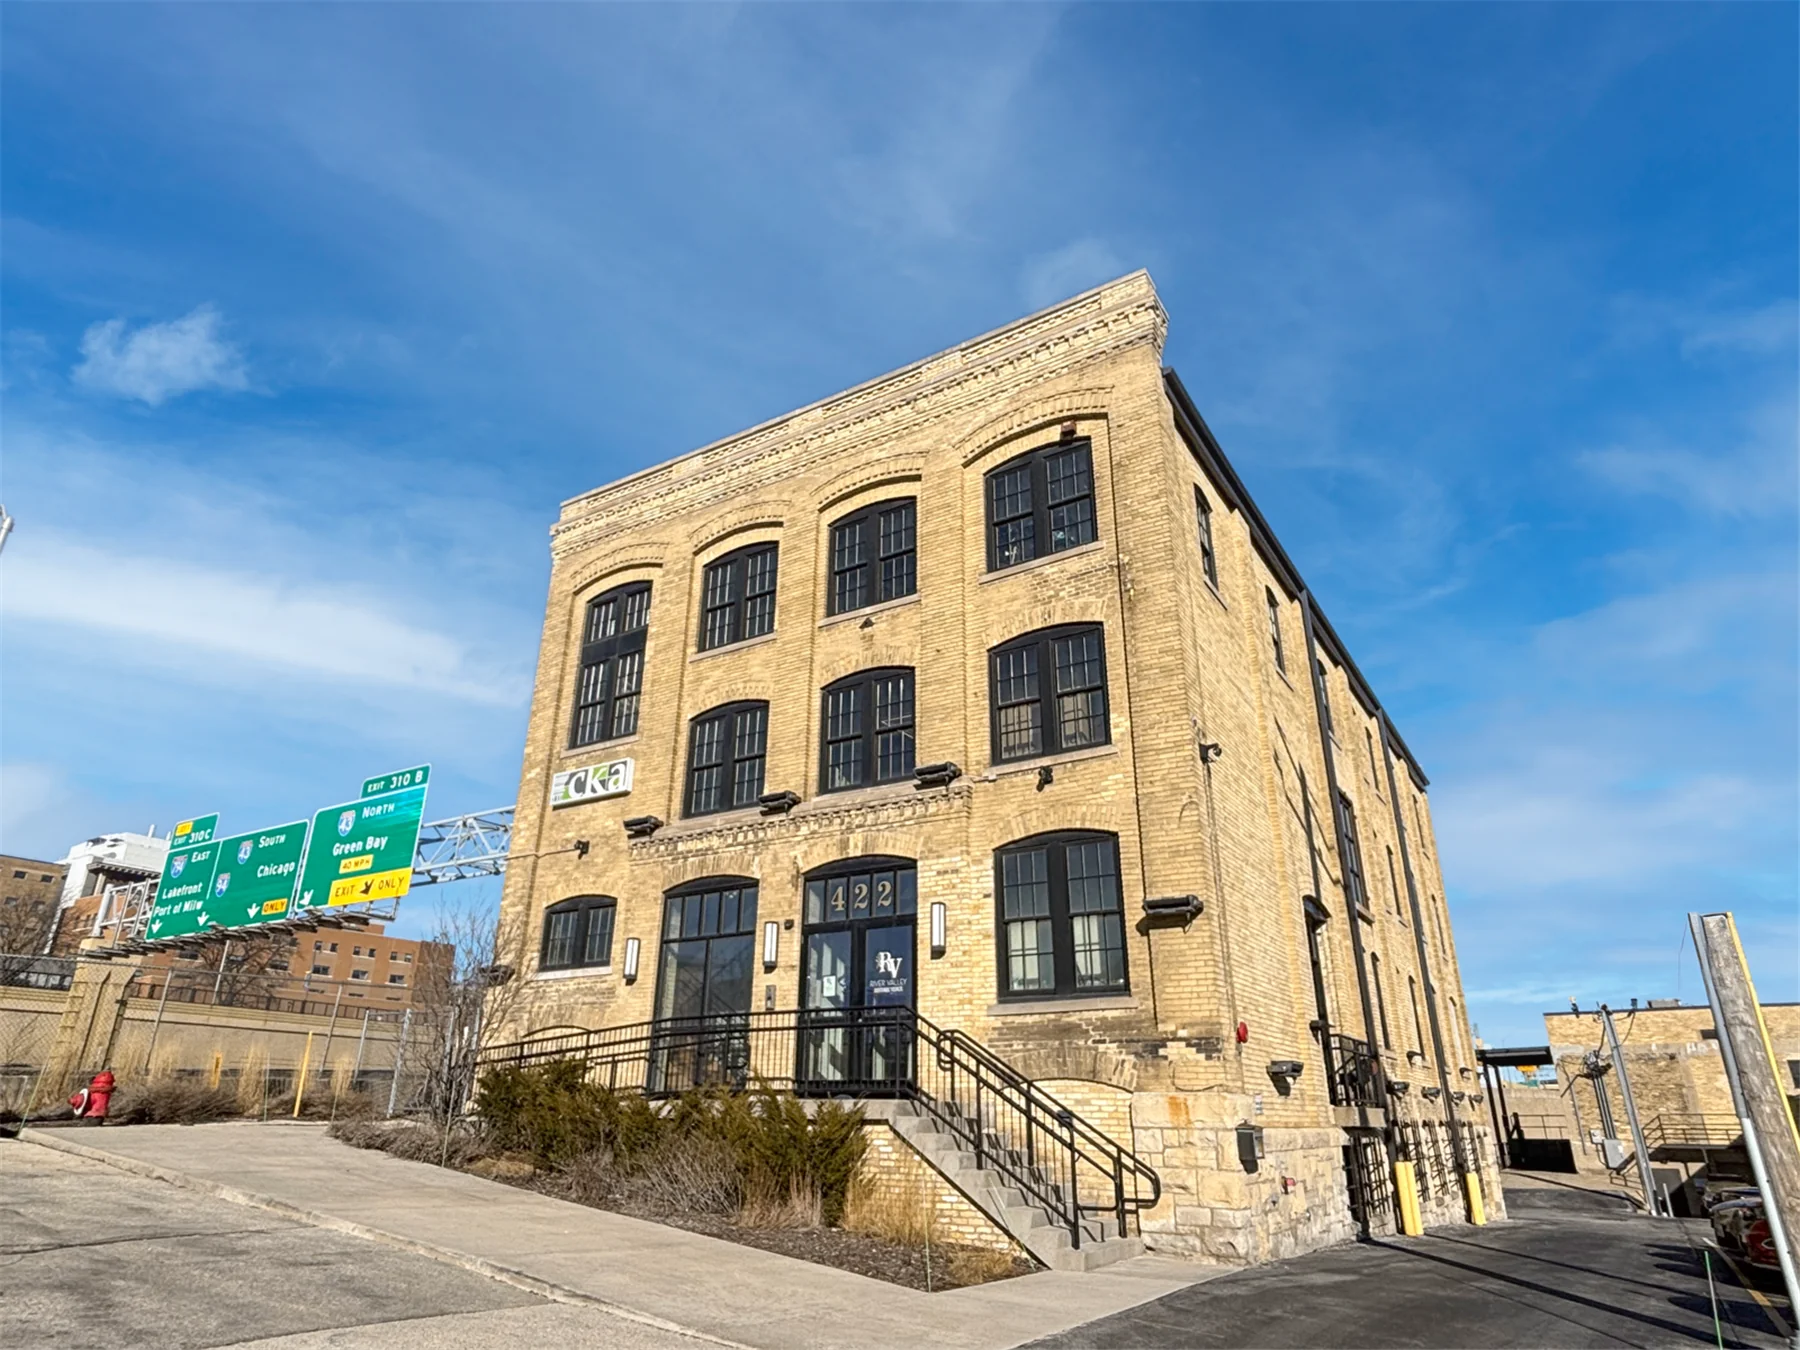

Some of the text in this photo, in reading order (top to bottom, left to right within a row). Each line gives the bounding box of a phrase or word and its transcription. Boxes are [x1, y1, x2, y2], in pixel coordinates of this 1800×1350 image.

[367, 770, 424, 793] EXIT 310 B
[173, 829, 212, 845] EXIT 310C
[332, 836, 388, 856] Green Bay
[257, 862, 295, 878] Chicago
[342, 858, 370, 870] 40 MPH
[162, 882, 203, 899] Lakefront
[335, 877, 404, 897] EXIT ONLY
[831, 881, 892, 911] 422
[153, 900, 203, 917] Port of Milw
[263, 901, 286, 912] ONLY
[879, 951, 903, 979] RV
[887, 978, 907, 986] VALLEY
